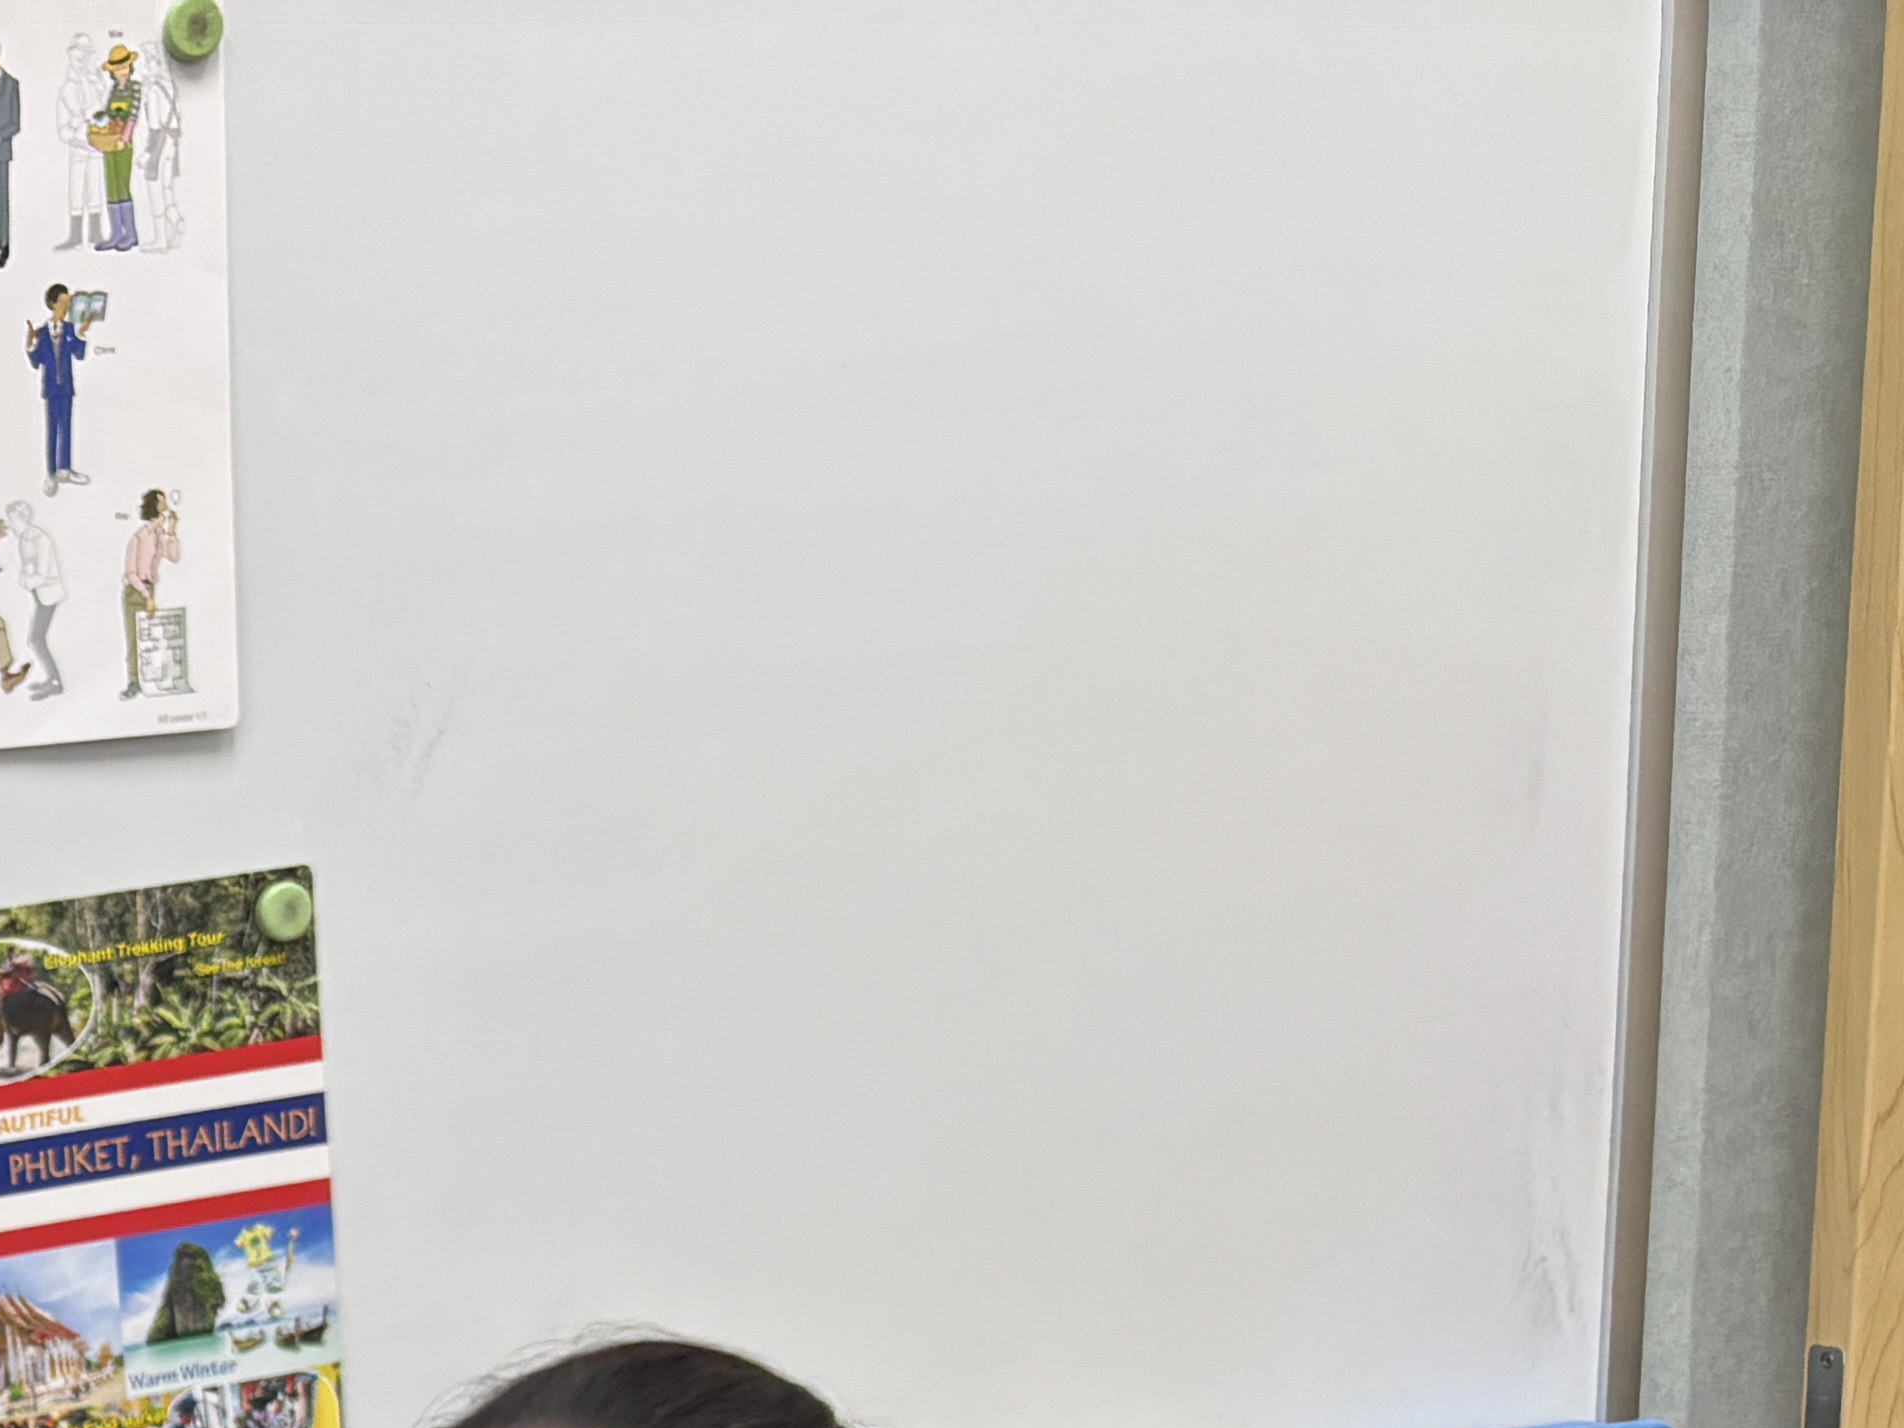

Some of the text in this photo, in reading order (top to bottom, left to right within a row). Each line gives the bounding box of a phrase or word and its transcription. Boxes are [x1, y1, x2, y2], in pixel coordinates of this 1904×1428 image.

[44, 931, 227, 970] Elephant Trekking Tour
[9, 1106, 319, 1186] PHUKET, THAILAND!
[127, 1358, 238, 1391] Warm Winter
